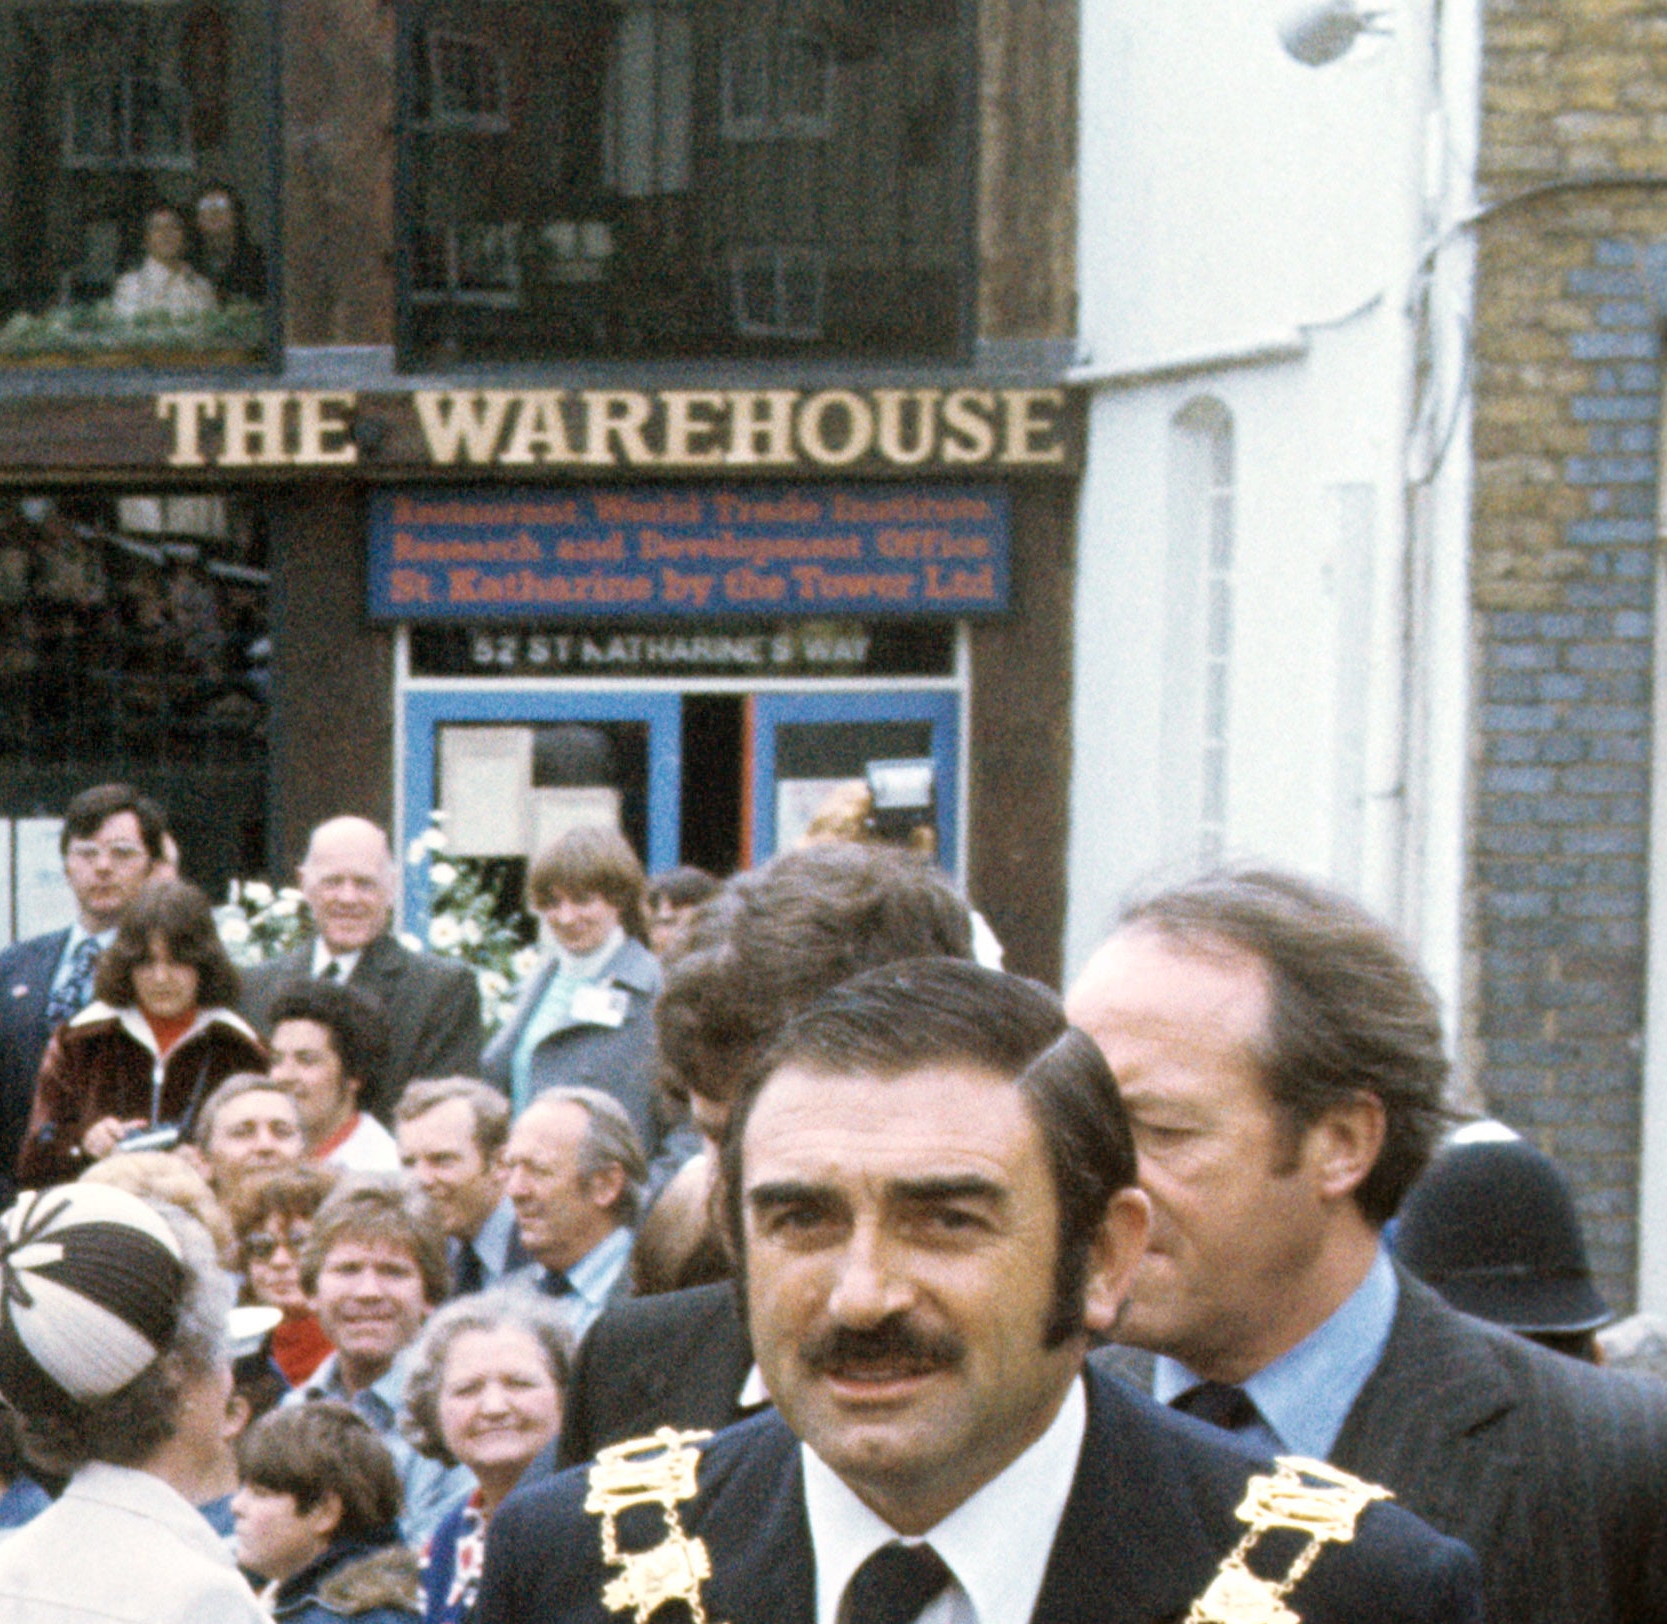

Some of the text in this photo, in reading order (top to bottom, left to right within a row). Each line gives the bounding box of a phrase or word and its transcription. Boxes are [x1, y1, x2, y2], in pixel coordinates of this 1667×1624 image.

[156, 388, 1065, 466] THE WAREHOUSE
[594, 495, 701, 523] World
[716, 494, 819, 523] Trade
[394, 529, 988, 566] Research and Development Office
[448, 569, 654, 602] Katharine
[662, 567, 714, 606] by
[723, 567, 786, 600] the
[790, 565, 915, 599] Tower
[923, 564, 995, 598] Ltd
[472, 634, 518, 665] 52
[527, 634, 570, 663] ST
[802, 634, 871, 663] WAY
